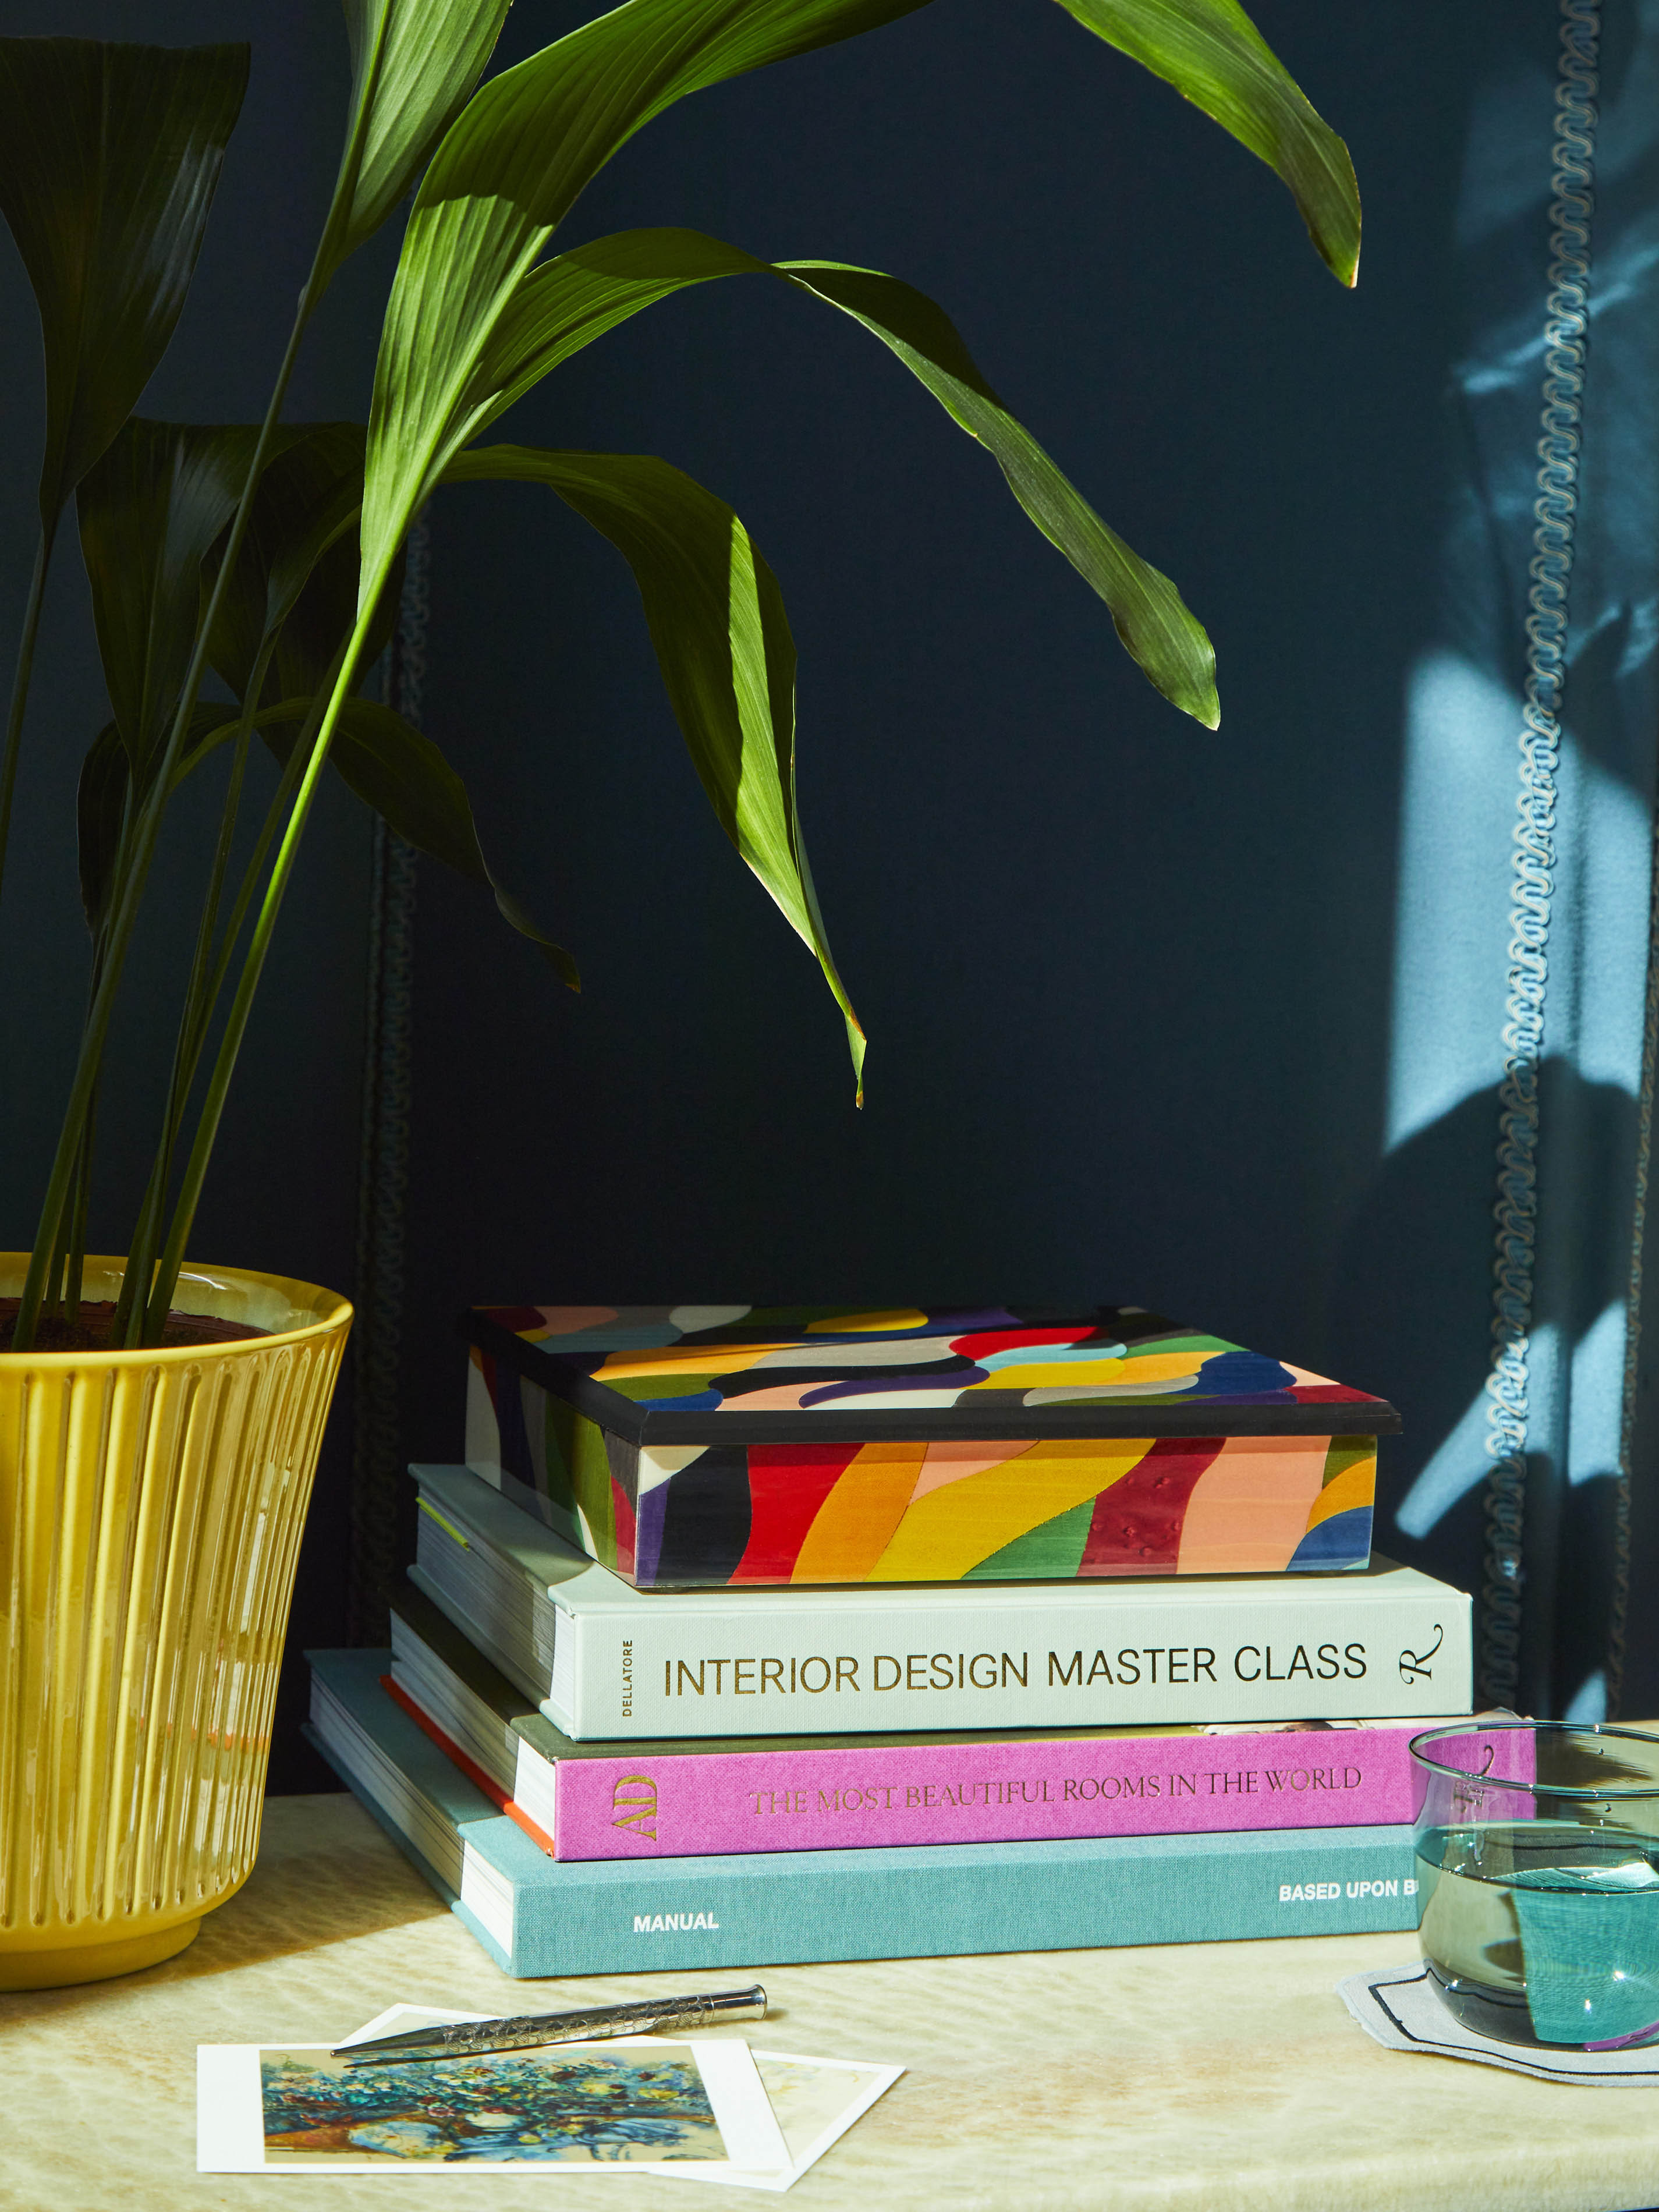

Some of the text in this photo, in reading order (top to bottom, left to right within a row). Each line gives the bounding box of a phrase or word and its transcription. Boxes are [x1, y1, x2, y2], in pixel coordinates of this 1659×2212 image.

[622, 1639, 633, 1717] DELLATORE
[665, 1643, 1367, 1696] INTERIOR DESIGN MASTER CLASS
[1399, 1623, 1444, 1685] R
[611, 1774, 658, 1842] AD
[749, 1767, 1362, 1814] THE MOST BEAUTIFUL ROOMS IN THE WORLD
[1278, 1881, 1341, 1902] BASED
[1346, 1879, 1398, 1899] UPON
[633, 1910, 720, 1933] MANUAL
